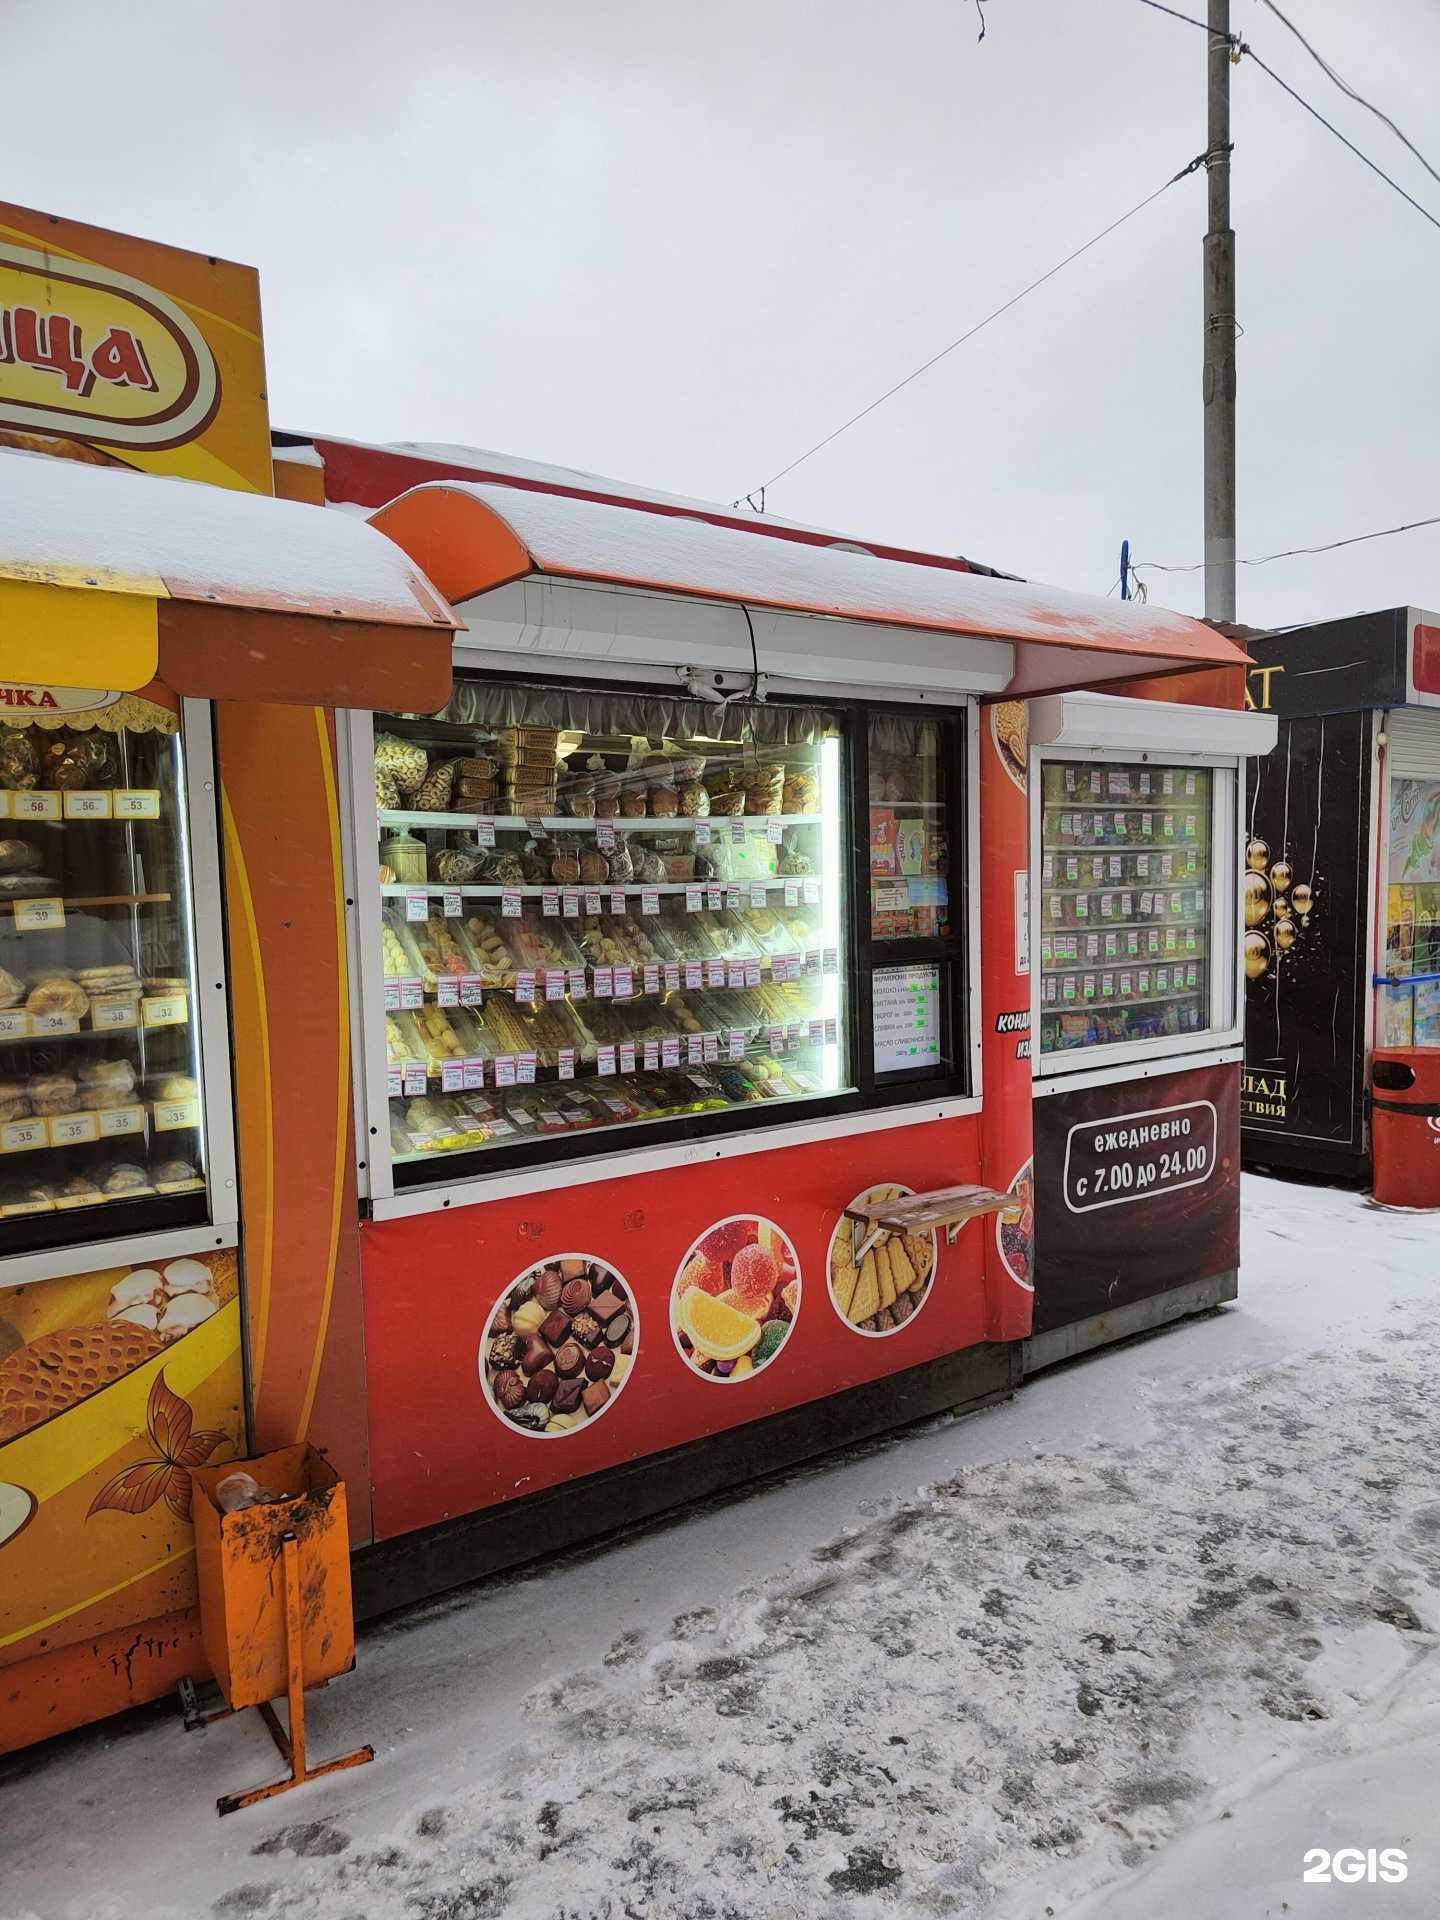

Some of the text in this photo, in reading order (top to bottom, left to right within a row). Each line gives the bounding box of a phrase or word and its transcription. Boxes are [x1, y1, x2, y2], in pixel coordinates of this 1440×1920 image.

[0, 307, 159, 397] ца
[31, 801, 44, 812] 58
[82, 801, 95, 811] 56
[130, 801, 143, 810] 53
[34, 911, 49, 921] 39
[49, 1017, 64, 1028] 34
[173, 1111, 185, 1122] 35
[115, 1118, 129, 1128] 35
[18, 1131, 33, 1142] 35
[68, 1126, 82, 1137] 35
[1094, 1118, 1191, 1153] ежедневно
[1094, 1162, 1133, 1193] 7.00
[1136, 1162, 1156, 1189] до
[1159, 1145, 1207, 1179] 24.00
